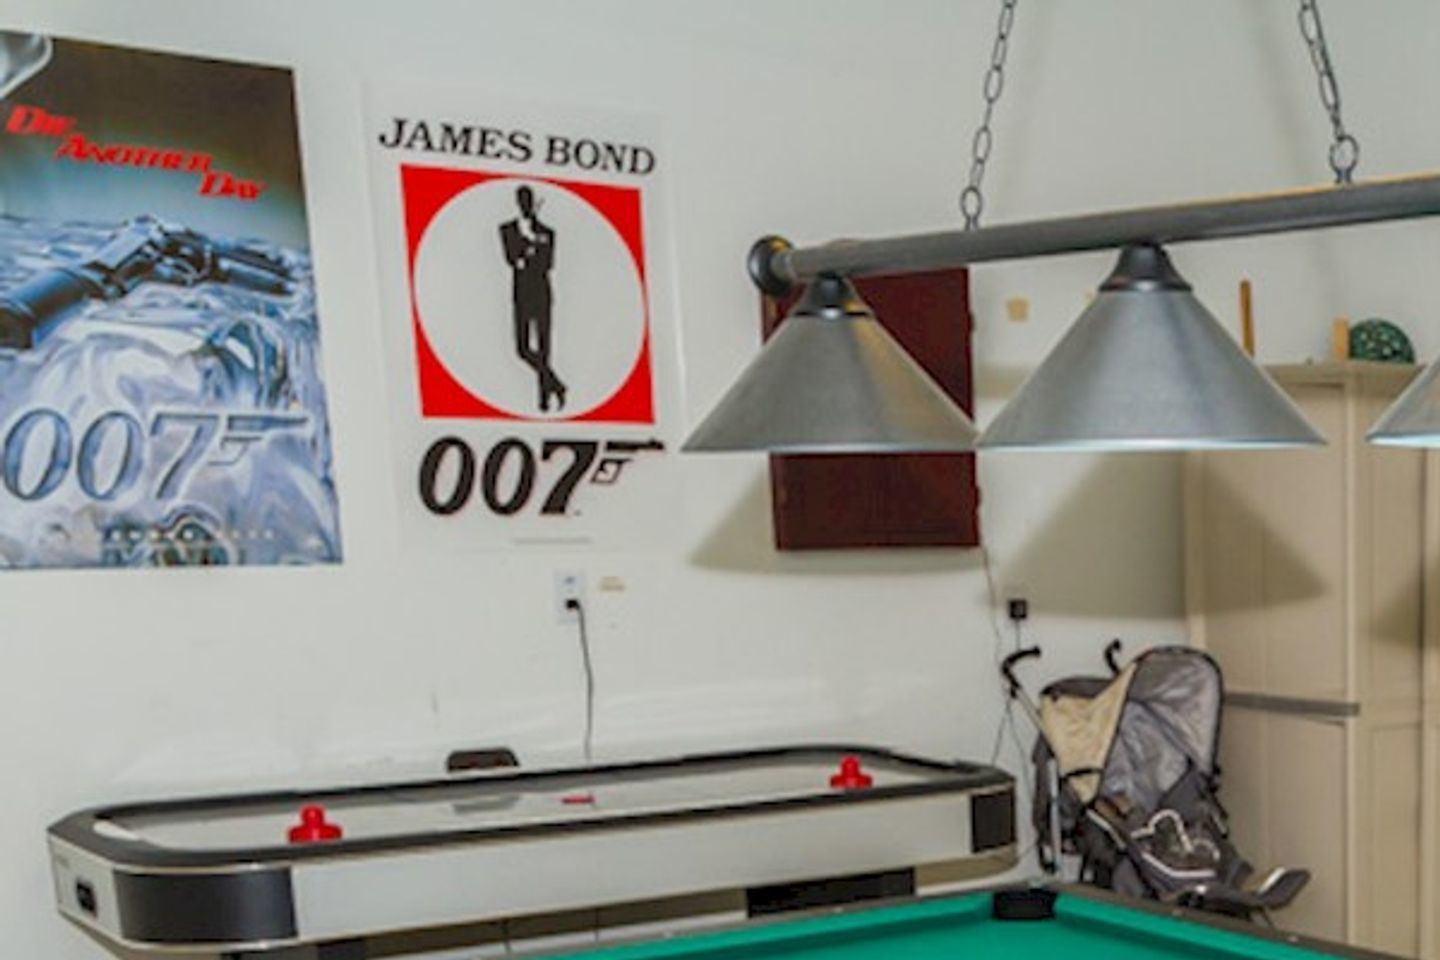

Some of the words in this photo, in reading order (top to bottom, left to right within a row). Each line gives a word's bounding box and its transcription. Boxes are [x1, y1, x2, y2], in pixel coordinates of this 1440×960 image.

[379, 117, 533, 163] JAMES
[544, 135, 656, 175] BOND
[2, 407, 220, 501] 007
[418, 434, 598, 517] 007
